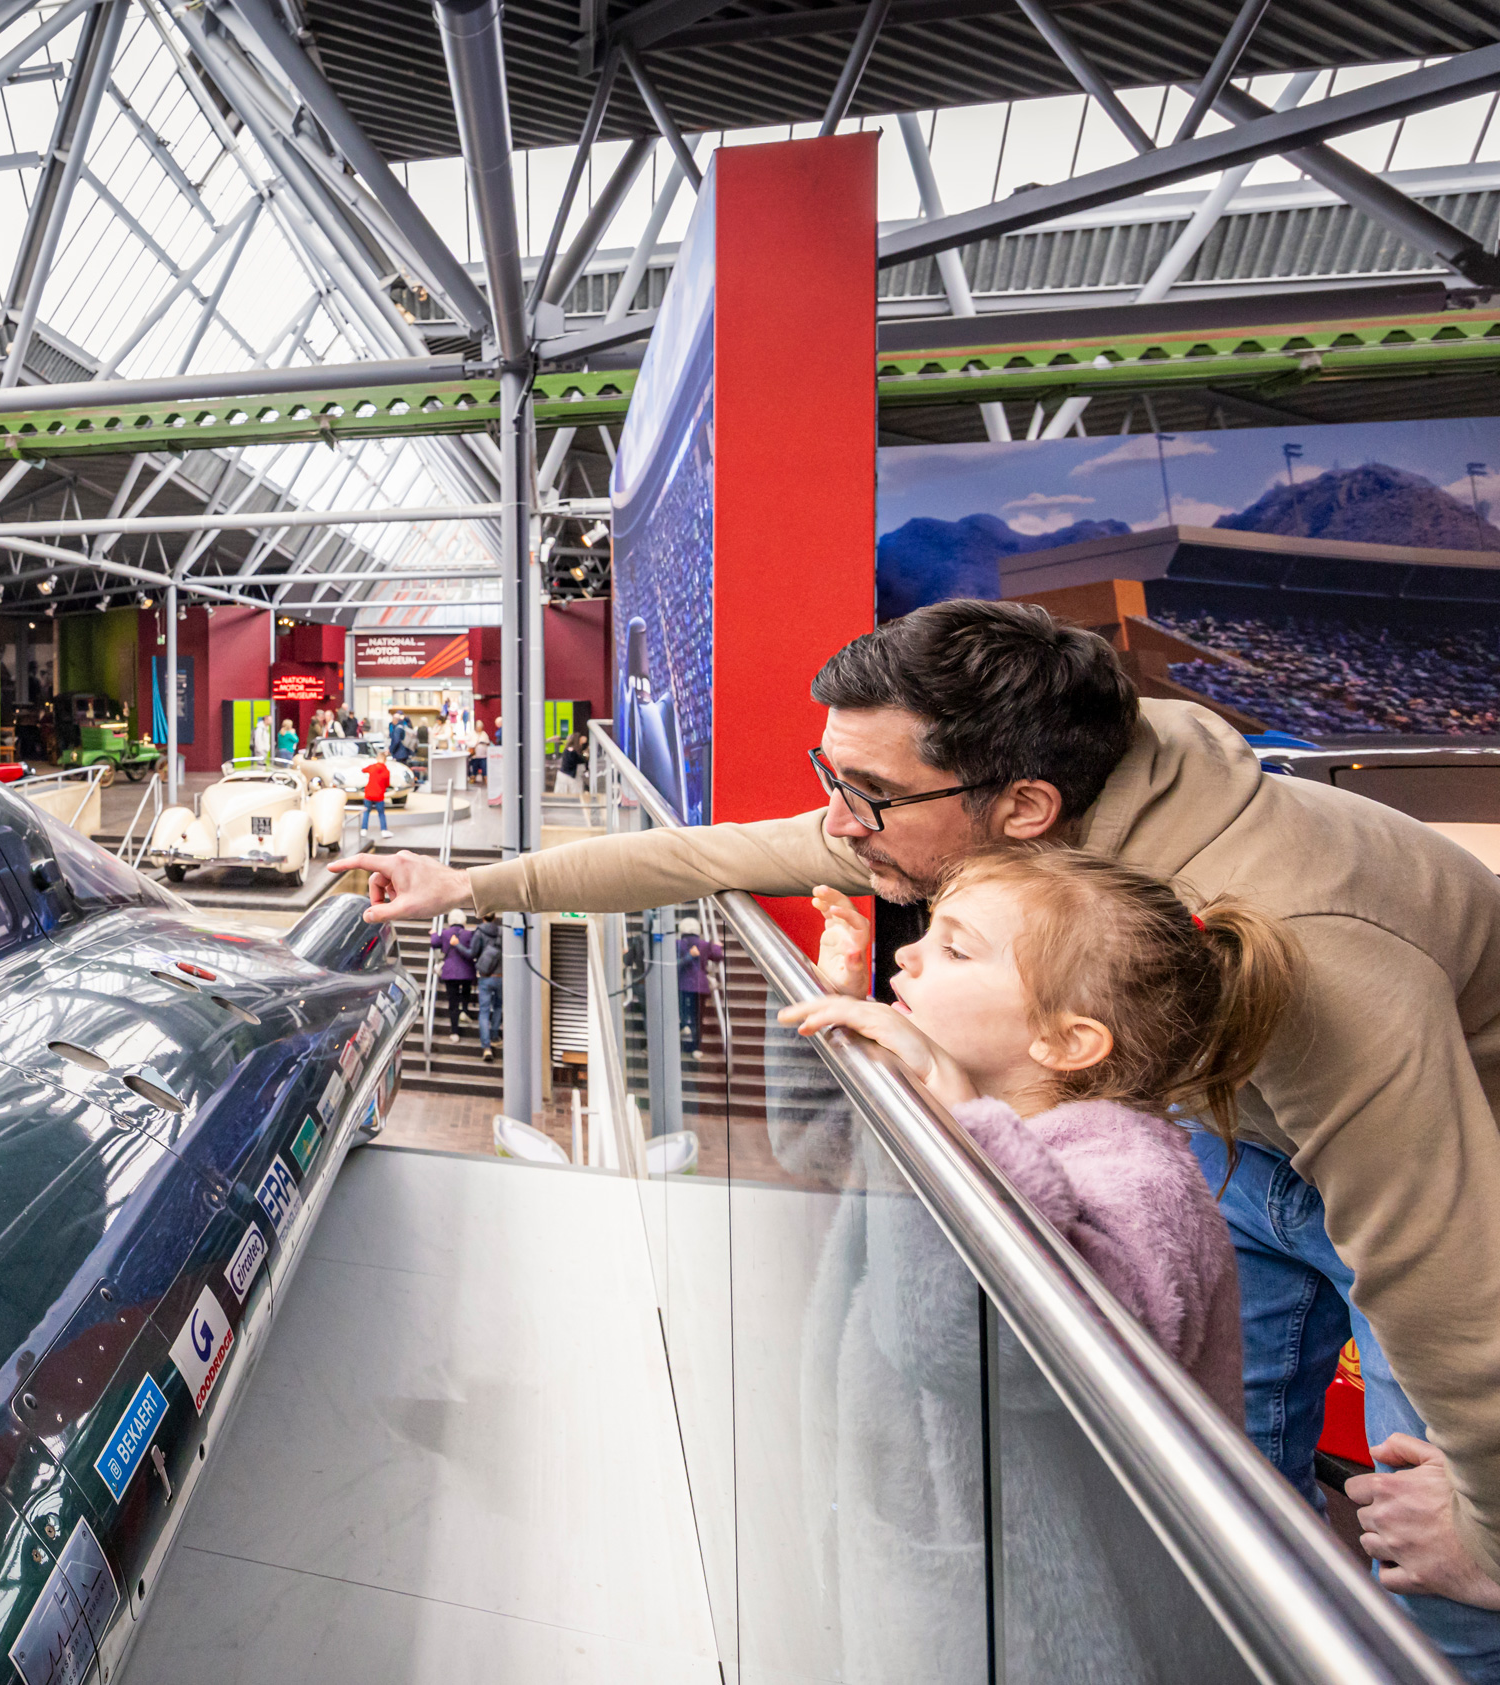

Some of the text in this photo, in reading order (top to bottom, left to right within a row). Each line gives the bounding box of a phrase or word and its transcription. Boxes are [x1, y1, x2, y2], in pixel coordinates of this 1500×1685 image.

[368, 637, 416, 646] NATIONAL
[365, 646, 400, 656] MOTOR
[377, 656, 418, 665] MUSEUM
[281, 676, 317, 685] NATIONAL
[279, 684, 305, 692] MOTOR
[287, 691, 318, 700] MUSEUM
[257, 1160, 297, 1230] ERA
[237, 1239, 261, 1287] zircotec
[195, 1328, 234, 1410] GOODRIDGE
[116, 1389, 158, 1465] BEKAERT
